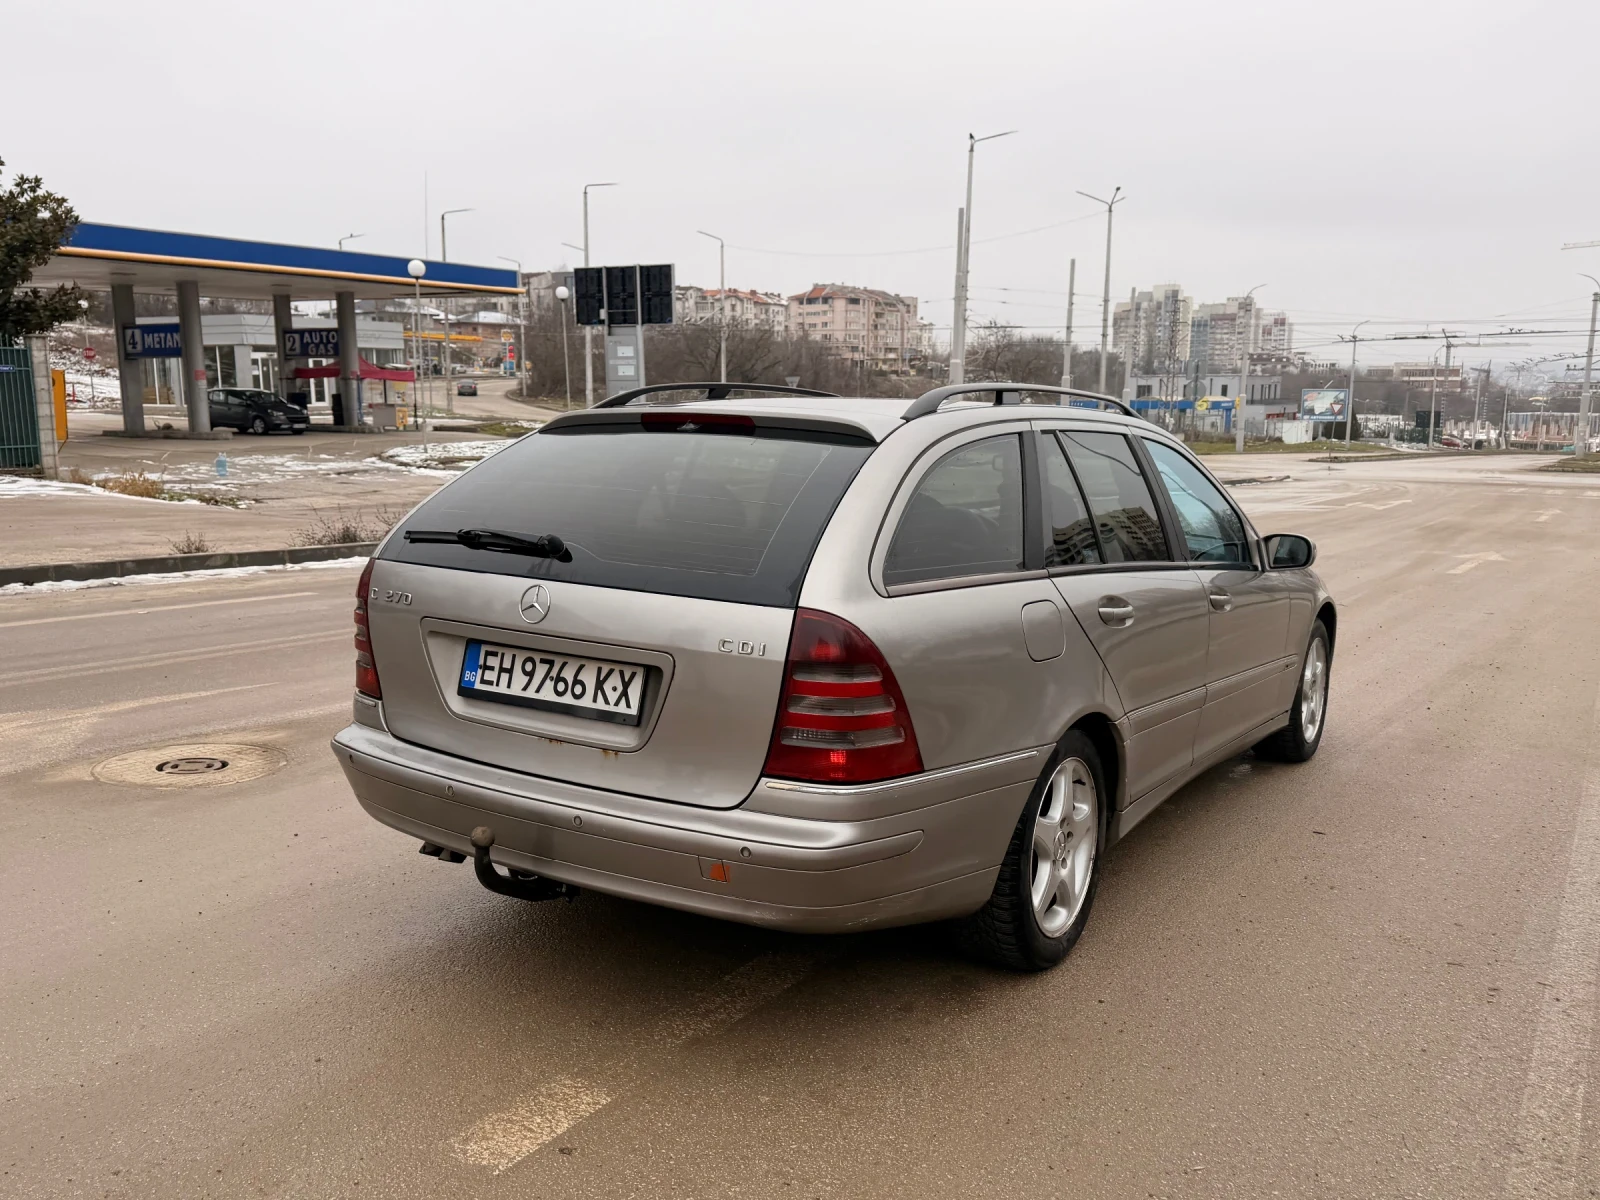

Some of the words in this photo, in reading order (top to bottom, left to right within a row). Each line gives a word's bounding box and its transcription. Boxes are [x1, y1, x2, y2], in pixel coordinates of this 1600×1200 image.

[128, 330, 138, 350] 4
[143, 332, 181, 349] METAN
[287, 335, 297, 351] 2
[303, 331, 338, 343] AUTO
[308, 343, 335, 356] GAS
[371, 587, 379, 600] C
[385, 590, 413, 605] 270
[718, 638, 767, 657] CDI
[464, 670, 476, 682] BG
[479, 650, 517, 689] EH
[520, 655, 587, 700] 9766
[592, 666, 638, 709] KX
